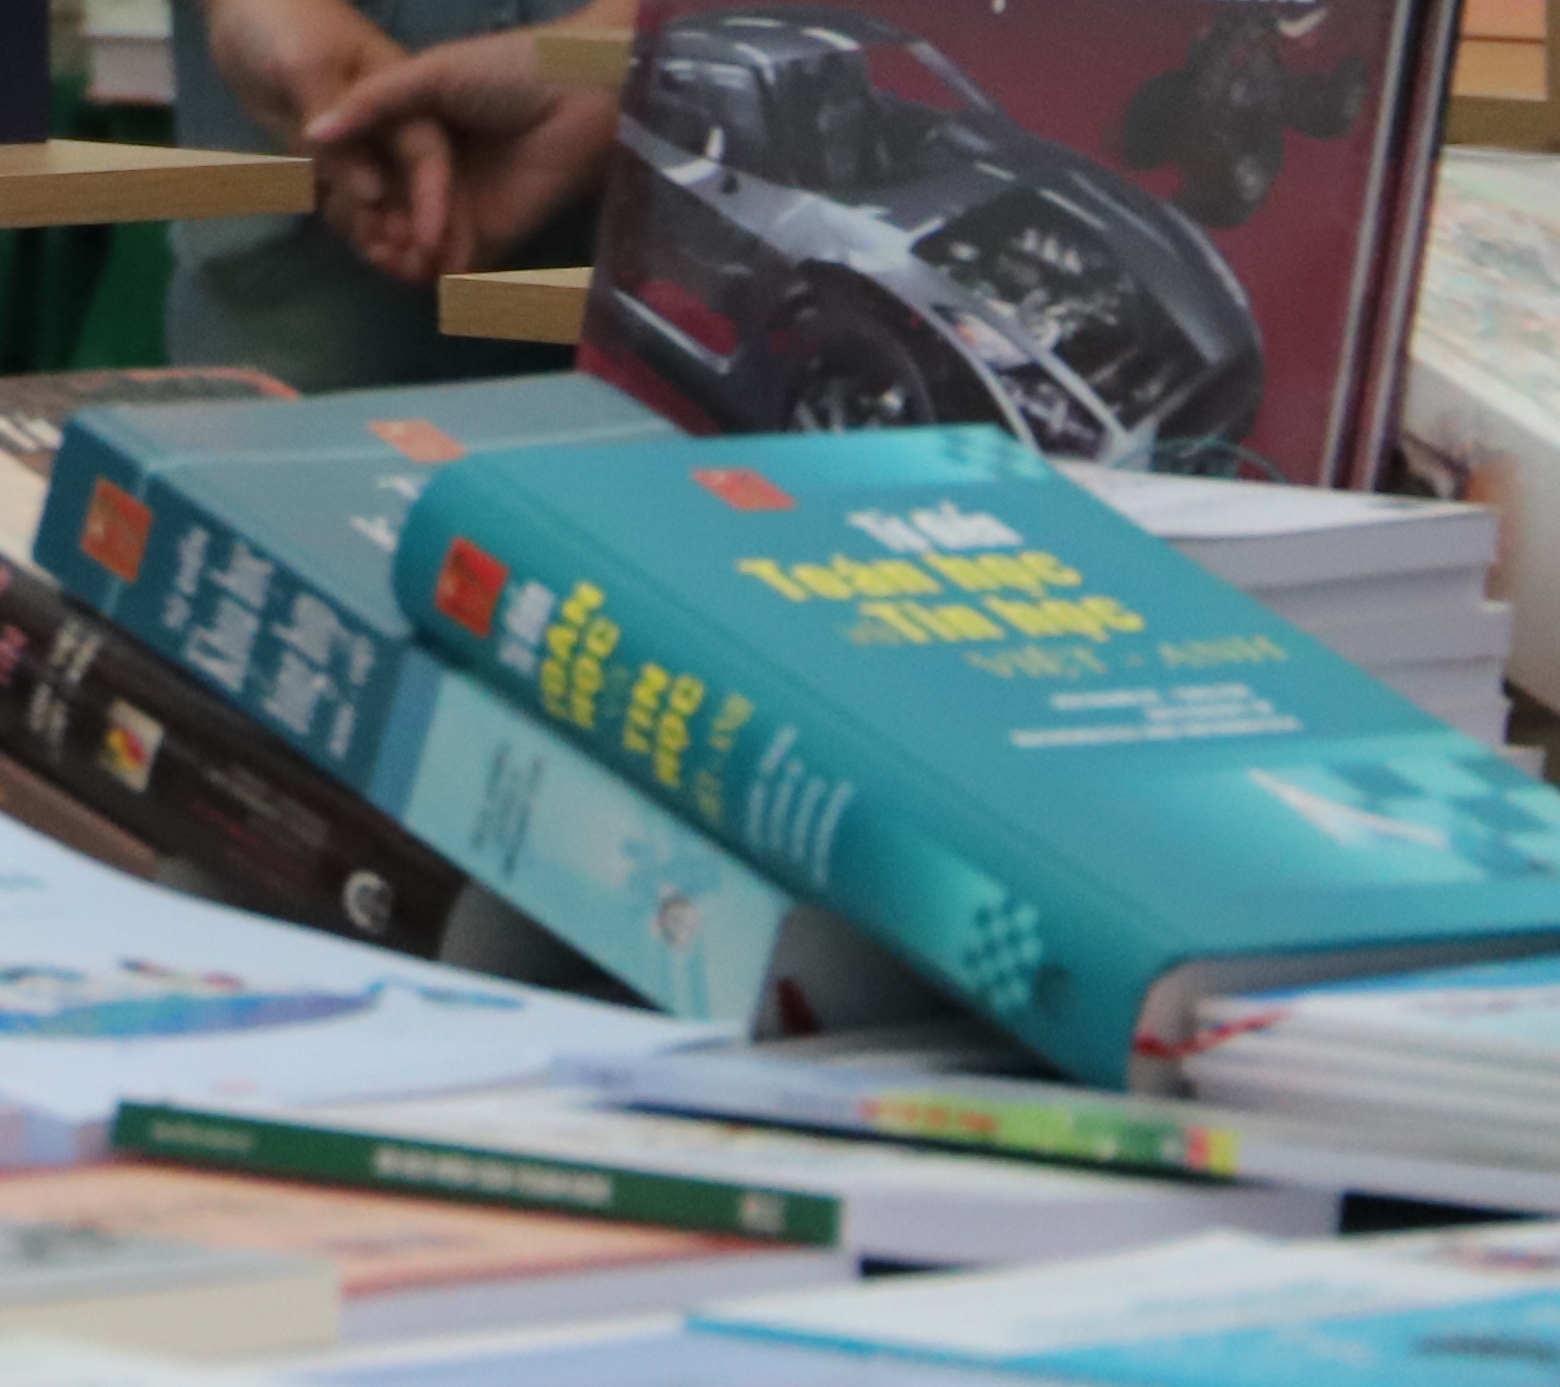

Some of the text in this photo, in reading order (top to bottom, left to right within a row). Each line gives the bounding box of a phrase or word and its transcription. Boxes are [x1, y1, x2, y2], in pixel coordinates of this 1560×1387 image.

[734, 549, 1085, 603] Toán học
[980, 594, 1147, 643] học
